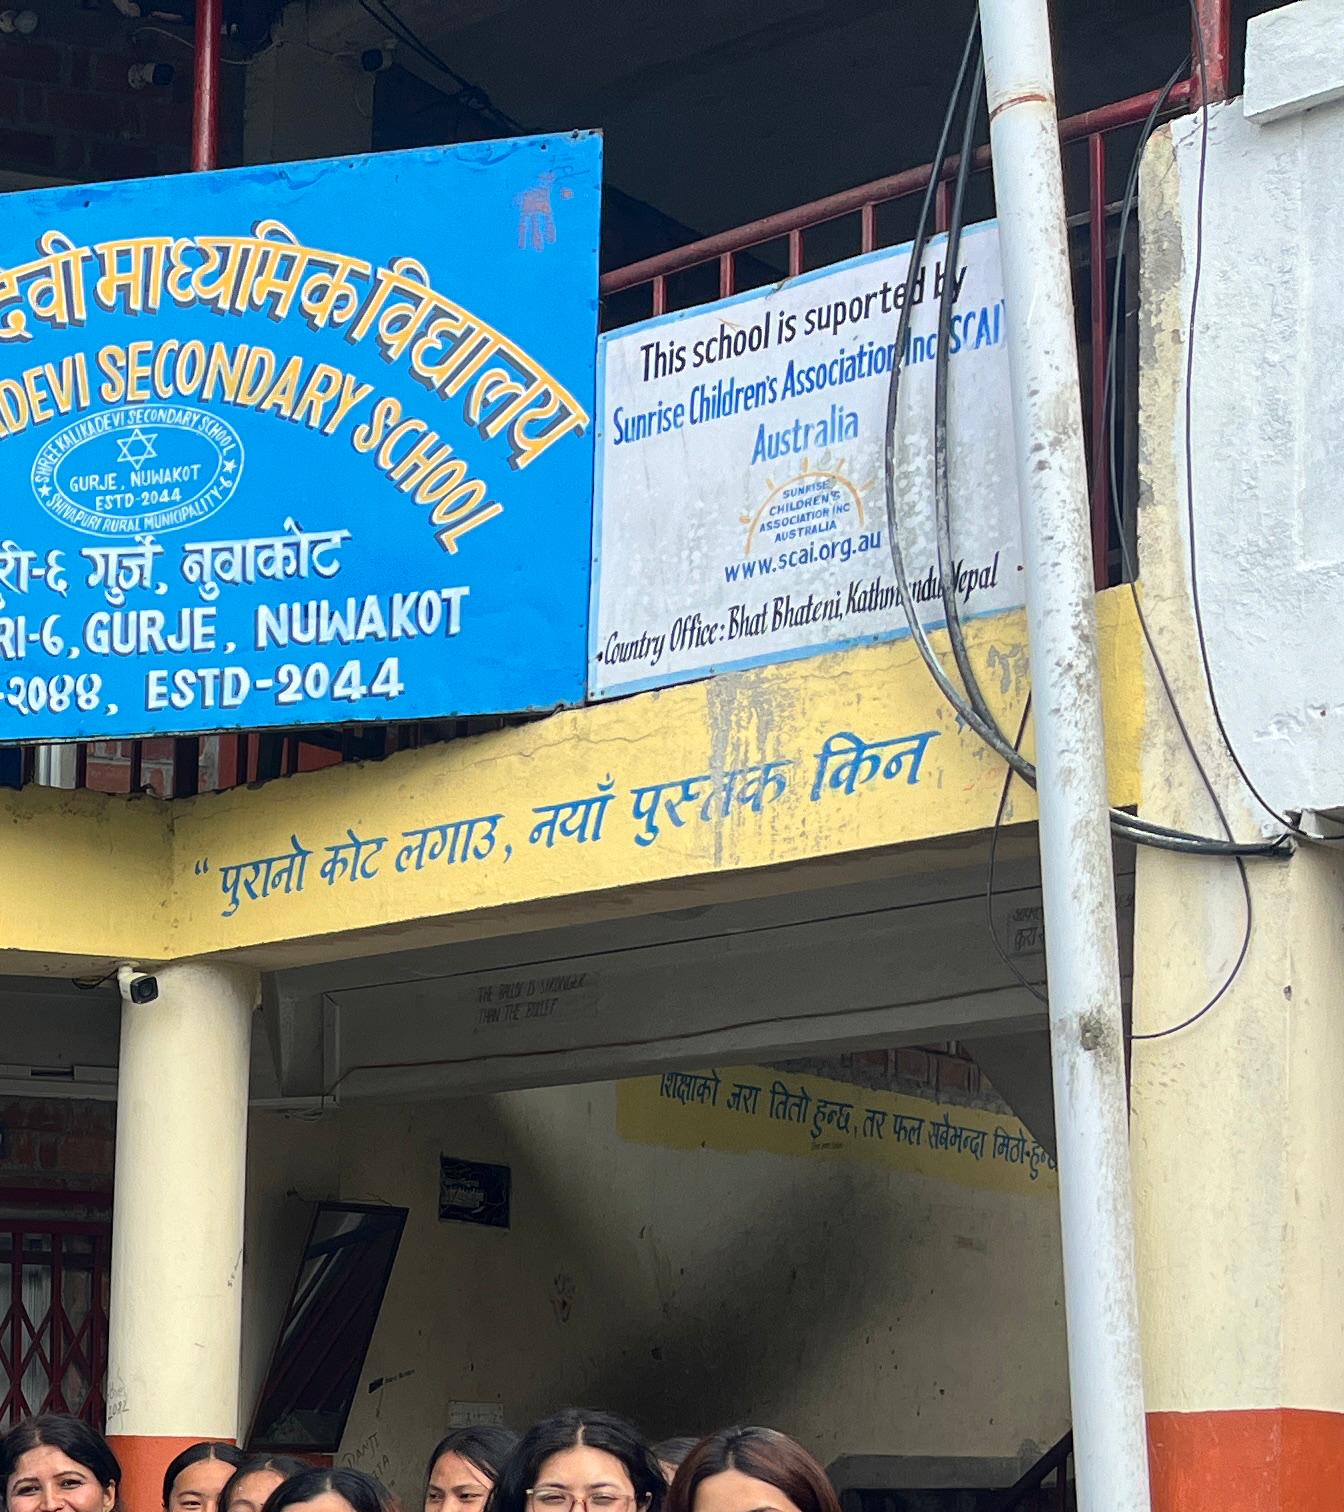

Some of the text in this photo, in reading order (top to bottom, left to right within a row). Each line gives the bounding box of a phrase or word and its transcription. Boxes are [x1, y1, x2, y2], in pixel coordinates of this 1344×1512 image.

[94, 219, 372, 330] माध्यमिक
[352, 256, 590, 471] विद्यालय
[641, 261, 967, 382] This school is suported by
[613, 401, 684, 446] Sunrise
[689, 374, 779, 426] Children's
[752, 405, 859, 465] Australia
[35, 408, 236, 483] SHREE KALIKADEVI SECONDARY SCHOOL
[97, 338, 374, 437] SECONDARY
[352, 396, 505, 555] SCHOOL
[131, 464, 202, 487] NUWAKOT
[45, 492, 102, 531] SHIVAPURI
[102, 517, 141, 532] RURAL
[95, 487, 182, 511] ESTD-2044
[759, 503, 850, 533] ASSOCIATION INC
[783, 480, 830, 499] SUNRISE
[182, 516, 352, 601] नुवाकोट
[724, 531, 881, 583] www.scai.org.au
[775, 520, 837, 543] AUSTRALIA
[255, 585, 470, 650] NUWAKOT
[604, 590, 844, 667] Country Office: Bhat Bhateni,
[146, 656, 405, 711] ESTD-2044
[319, 828, 389, 886] कोट
[528, 771, 616, 848] नयाँ
[809, 730, 942, 801] किन
